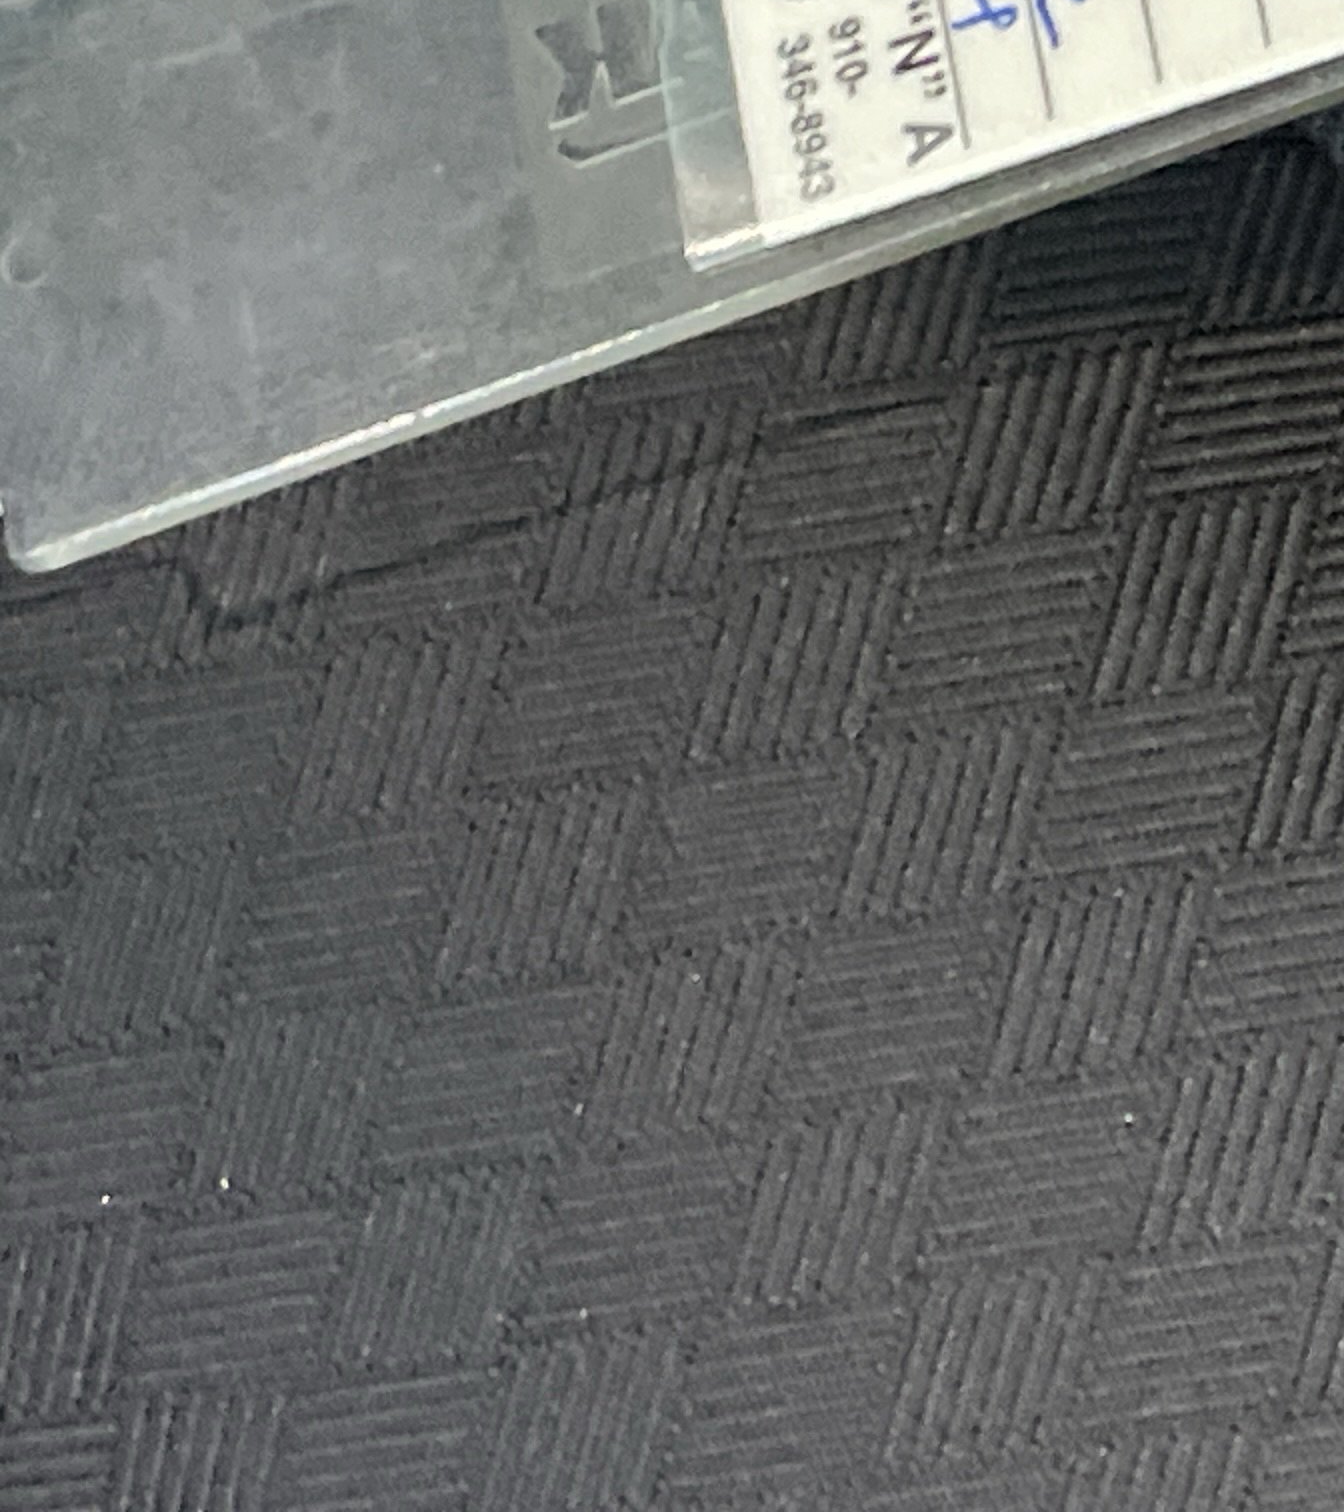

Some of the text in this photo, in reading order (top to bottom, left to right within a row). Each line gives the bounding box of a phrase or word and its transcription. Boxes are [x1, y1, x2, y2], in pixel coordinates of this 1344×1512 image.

[827, 16, 869, 98] 910-
[776, 33, 836, 203] 346-8943
[901, 123, 953, 168] A
